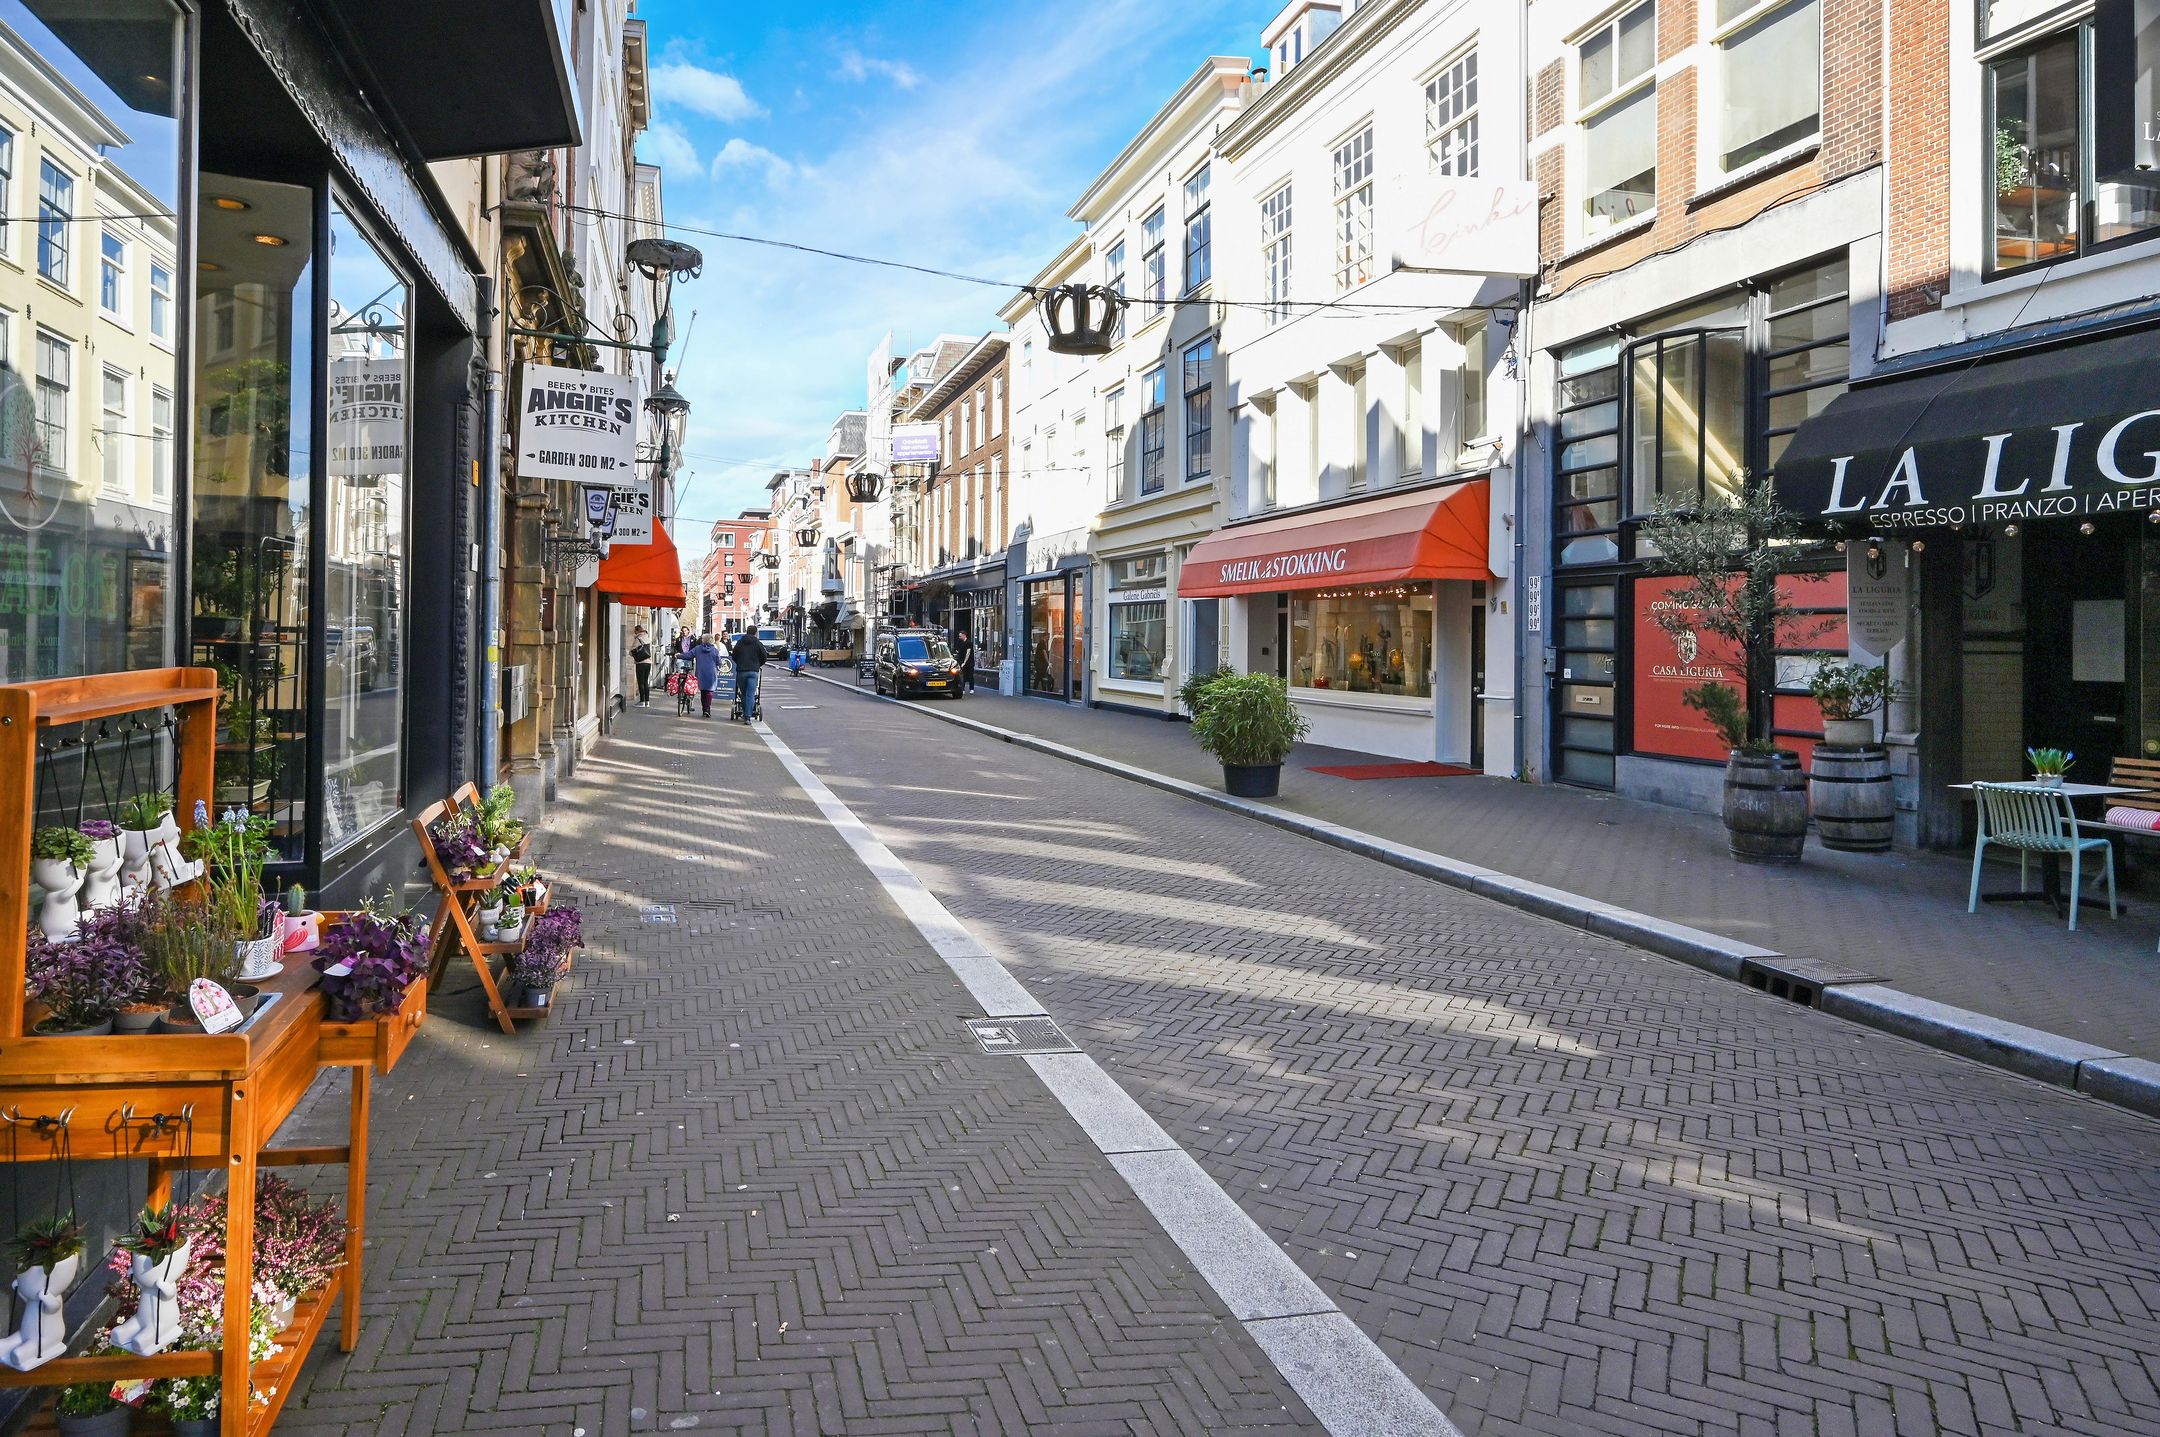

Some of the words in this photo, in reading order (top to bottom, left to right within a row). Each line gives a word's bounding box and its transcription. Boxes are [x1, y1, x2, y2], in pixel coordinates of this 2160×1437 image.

[547, 380, 577, 391] BEERS
[589, 385, 615, 396] BITES
[527, 387, 633, 424] ANGIE'S
[534, 414, 622, 436] KITCHEN
[539, 450, 576, 467] GARDEN
[578, 453, 597, 469] 300
[600, 456, 615, 471] M2
[1820, 446, 1929, 514] LA
[1971, 409, 2160, 500] LIG
[611, 492, 649, 509] GIE'S
[1869, 506, 1965, 529] ESPRESSO
[1983, 495, 2077, 521] PRANZO
[1219, 560, 1262, 583] SMELIK
[1271, 548, 1347, 578] STOKKING
[1123, 590, 1140, 601] Galerie
[1652, 665, 1677, 676] CASA
[1680, 666, 1724, 678] LIGURIA
